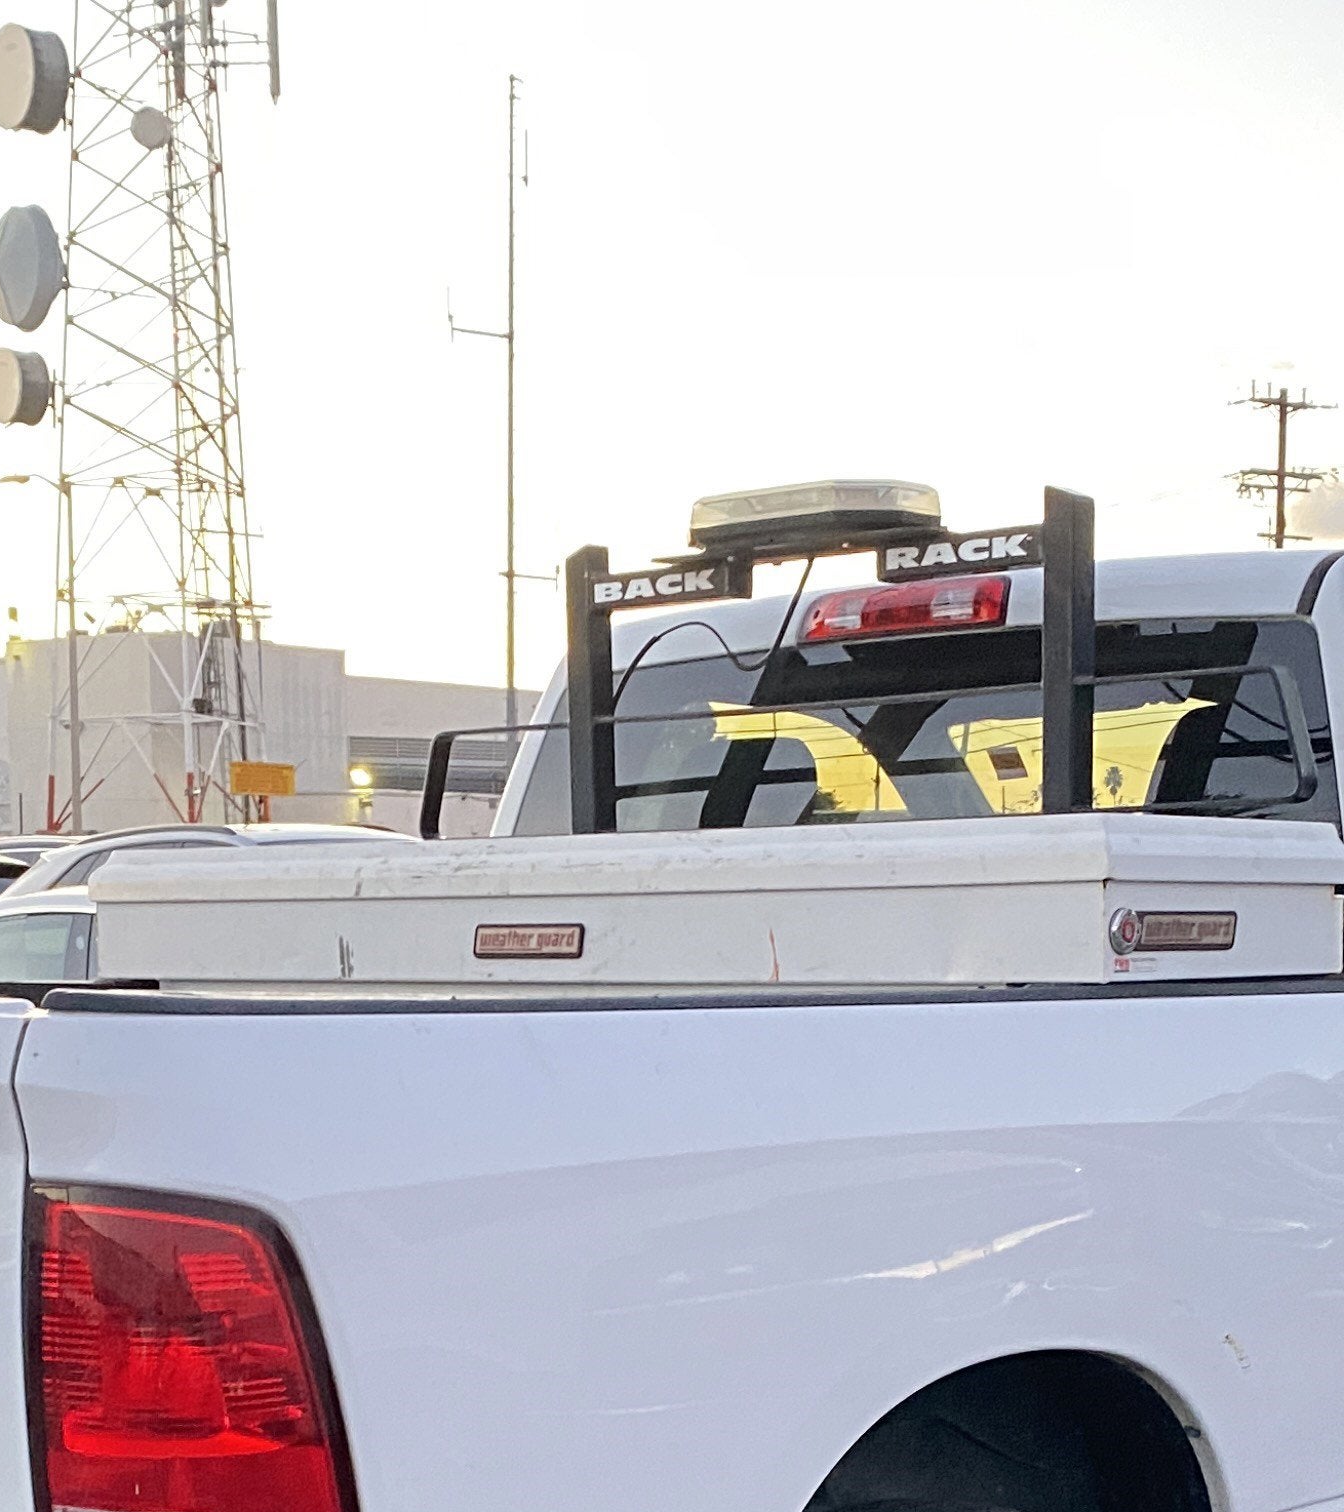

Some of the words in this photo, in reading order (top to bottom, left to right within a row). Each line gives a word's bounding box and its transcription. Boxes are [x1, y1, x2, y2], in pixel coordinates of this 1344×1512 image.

[593, 568, 715, 604] BACK
[885, 533, 1028, 571] RACK
[479, 930, 535, 948] weather
[536, 929, 576, 950] guard
